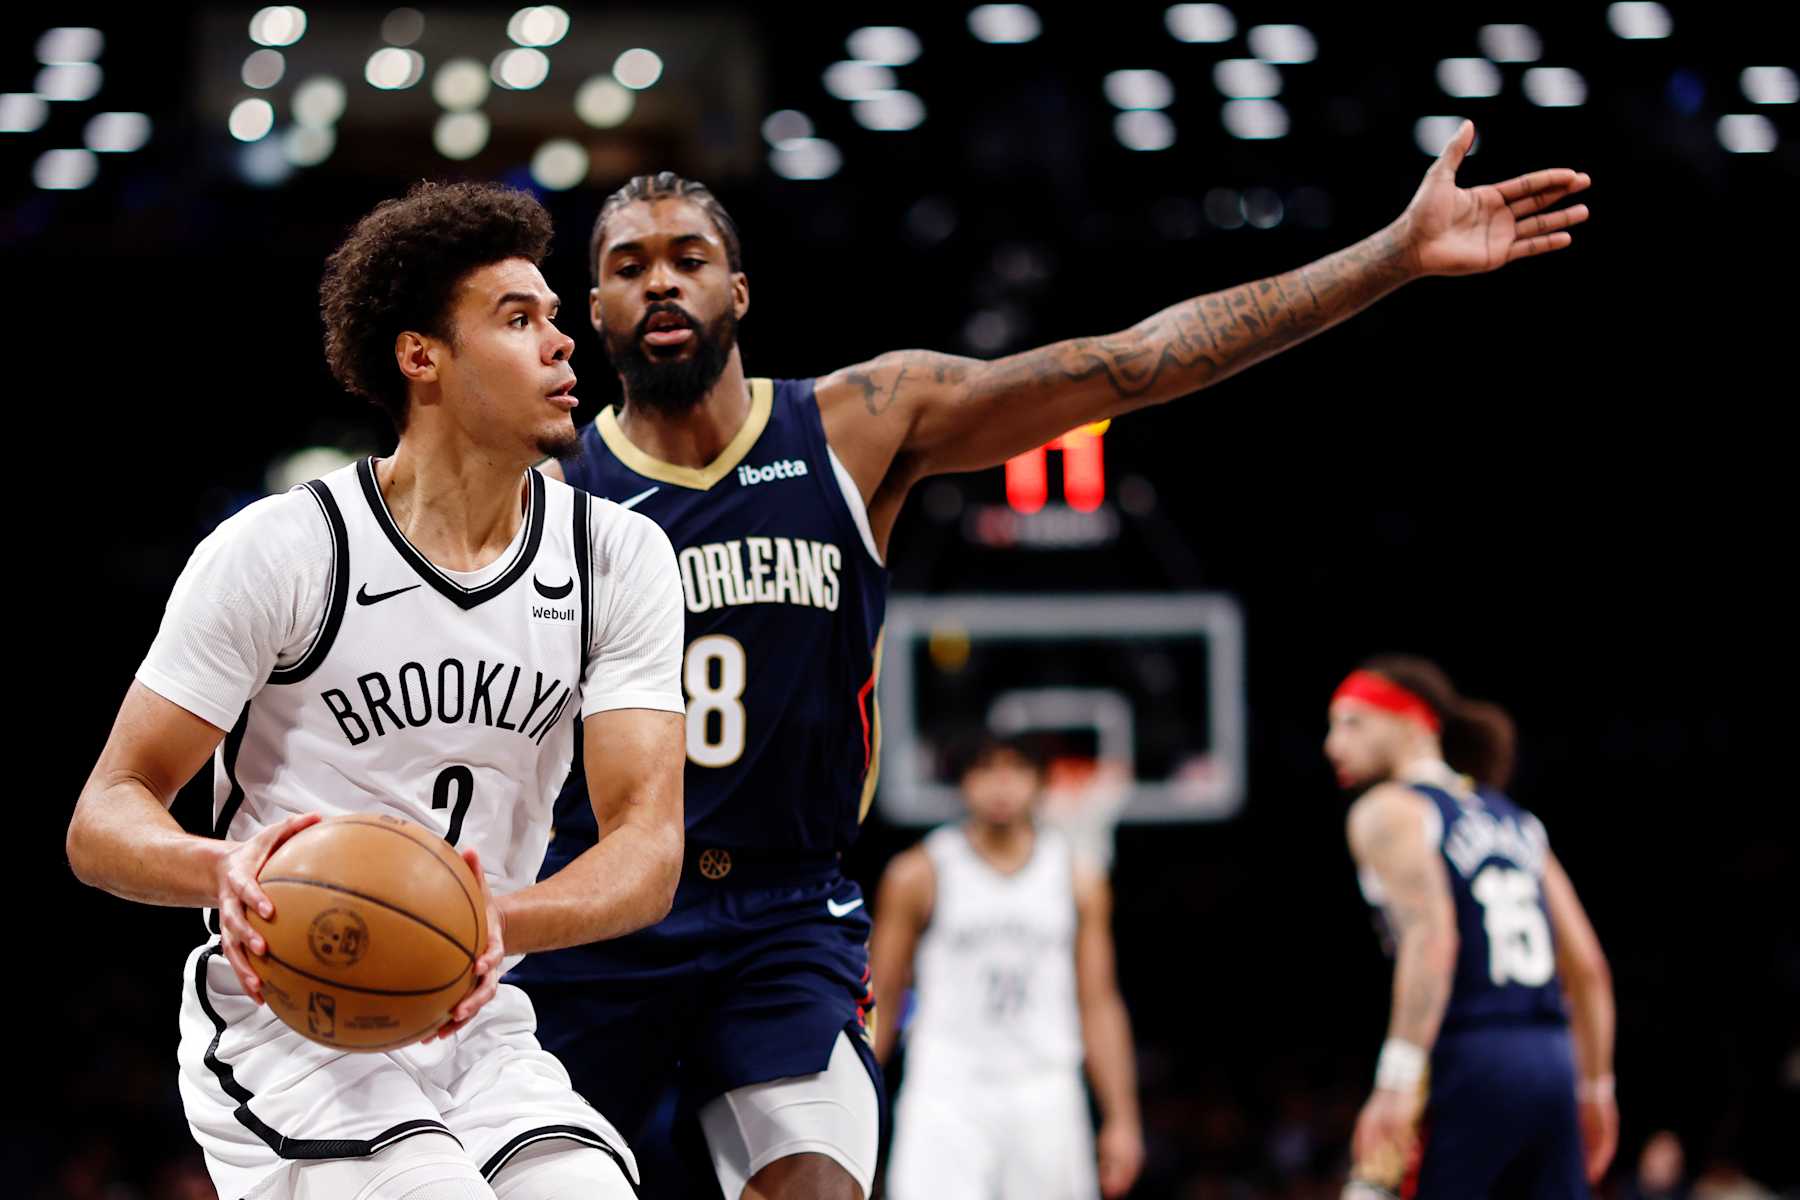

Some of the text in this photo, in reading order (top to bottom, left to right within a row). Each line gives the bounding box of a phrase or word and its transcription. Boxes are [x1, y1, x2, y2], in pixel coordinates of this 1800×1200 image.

[738, 459, 808, 486] ibotta
[532, 605, 575, 621] Webull
[679, 536, 842, 613] ORLEANS
[320, 657, 574, 746] BROOKLYN
[683, 633, 747, 768] 8
